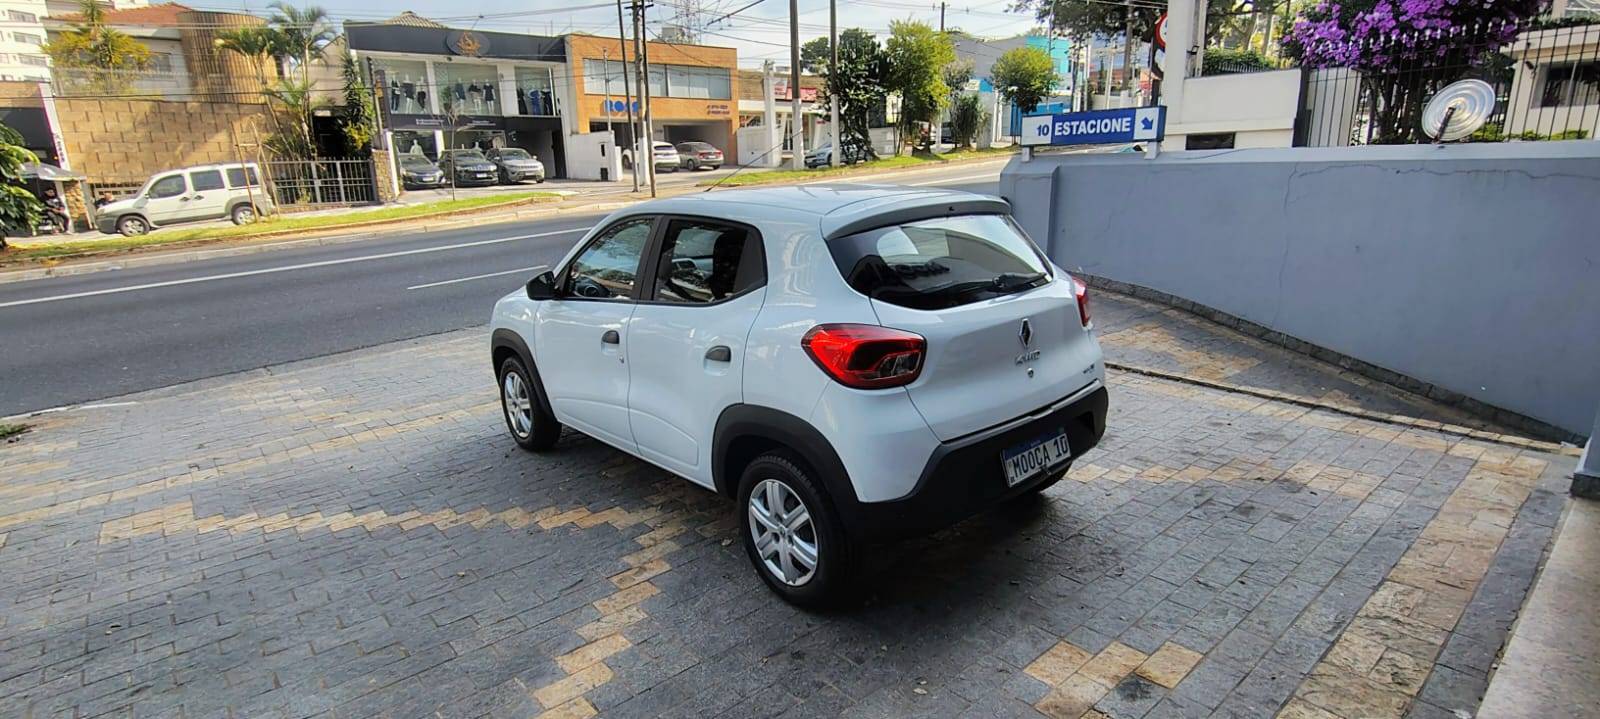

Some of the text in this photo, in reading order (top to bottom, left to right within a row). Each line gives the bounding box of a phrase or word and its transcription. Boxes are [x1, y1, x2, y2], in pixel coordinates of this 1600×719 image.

[1036, 117, 1132, 137] 10 ESTACIONE
[1012, 435, 1069, 478] MOOCA 10
